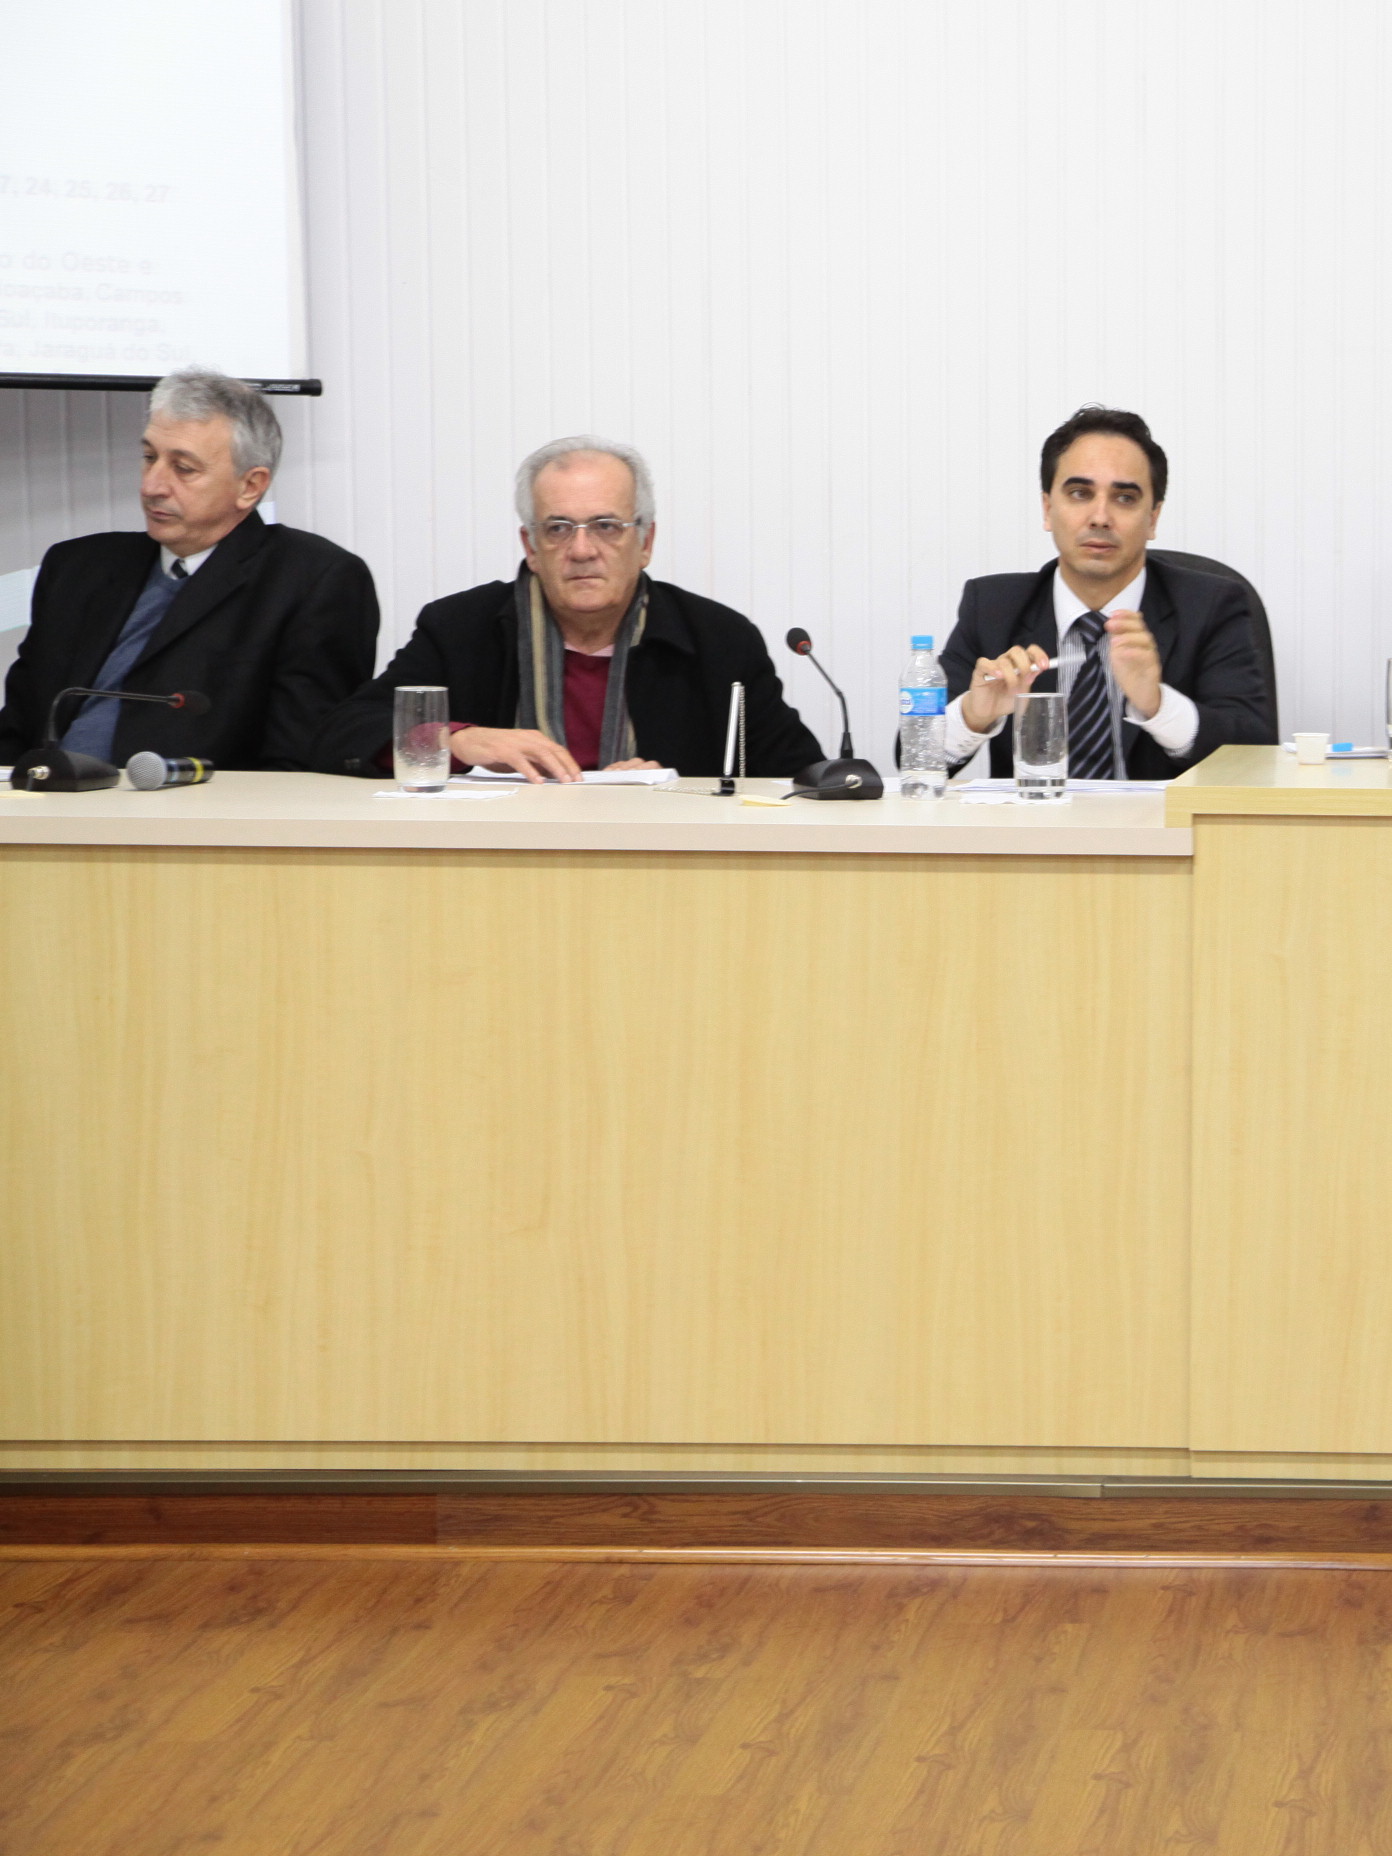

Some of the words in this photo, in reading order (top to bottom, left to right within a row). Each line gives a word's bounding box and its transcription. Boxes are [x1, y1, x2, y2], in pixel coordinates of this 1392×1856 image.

[145, 184, 171, 204] 27
[22, 250, 51, 271] do
[61, 251, 130, 273] Oeste
[95, 282, 184, 306] Campos
[28, 341, 115, 363] Jaraguá
[122, 343, 149, 362] do
